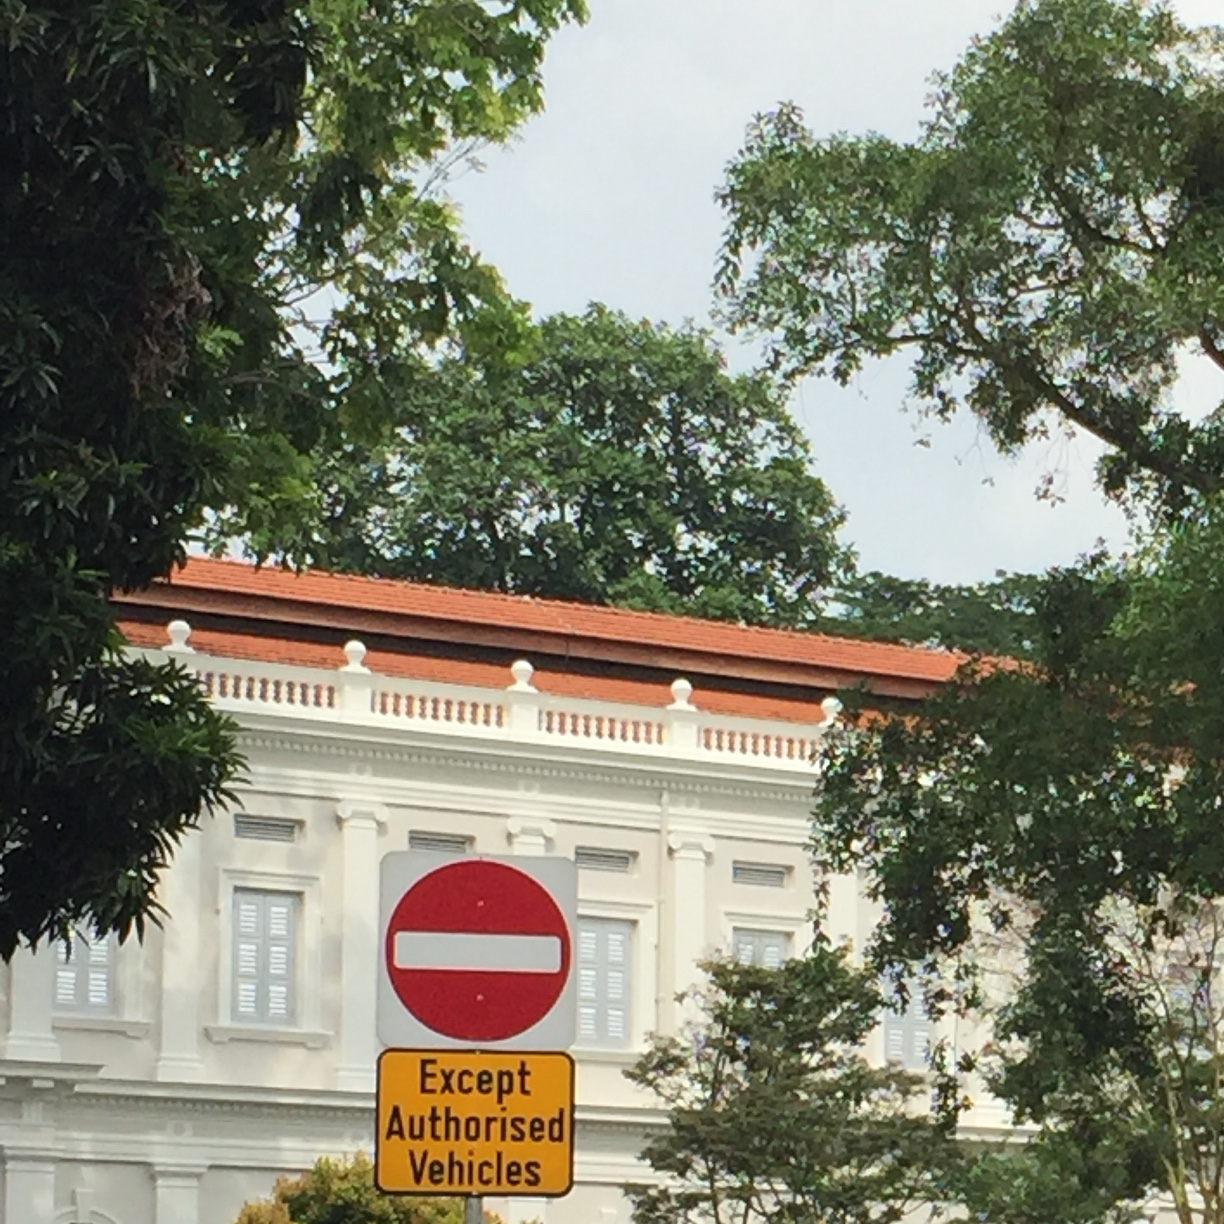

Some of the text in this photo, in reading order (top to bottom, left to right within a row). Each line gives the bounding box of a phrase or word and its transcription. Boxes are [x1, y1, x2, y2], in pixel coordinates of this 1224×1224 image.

[419, 1058, 532, 1105] Except
[385, 1104, 565, 1143] Authorised
[408, 1149, 542, 1187] Vehicles
